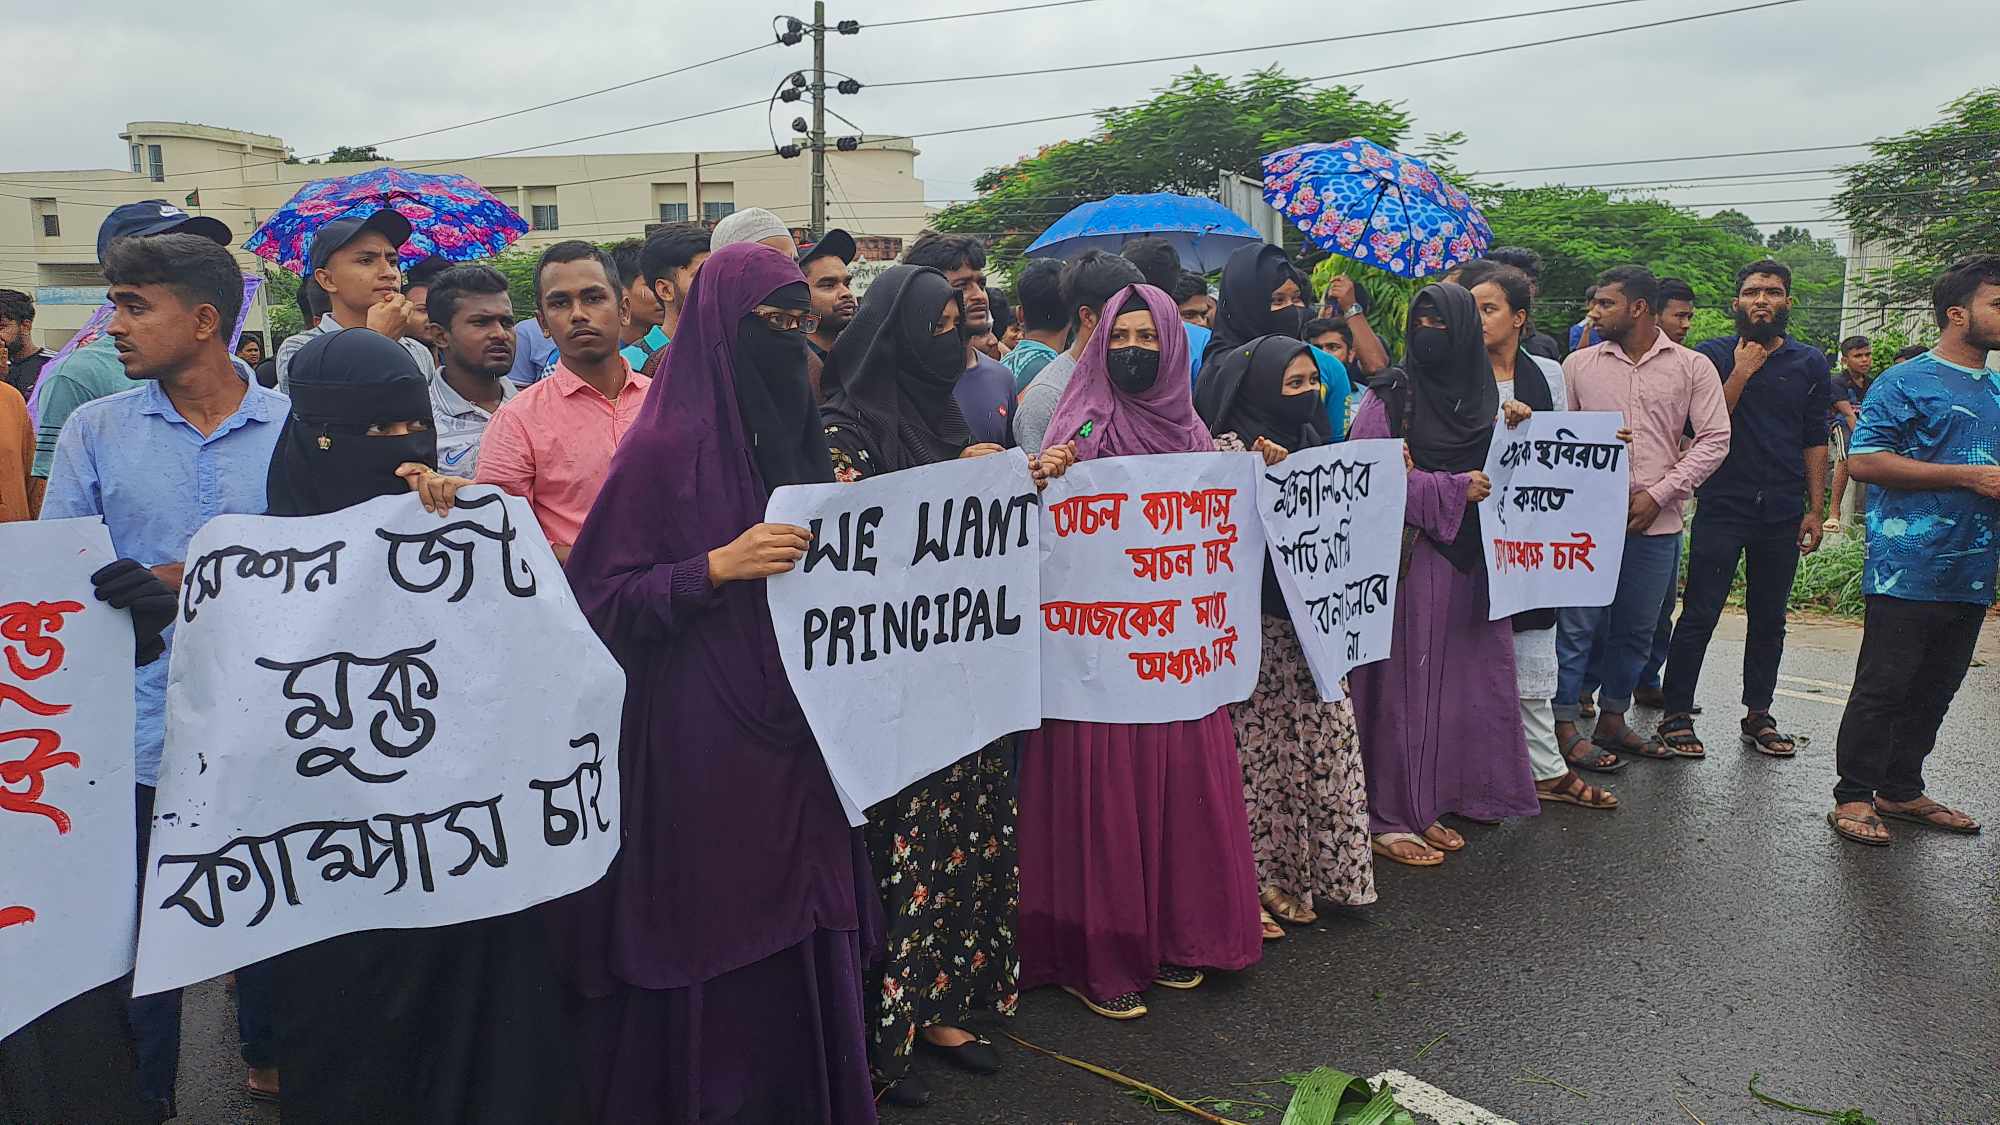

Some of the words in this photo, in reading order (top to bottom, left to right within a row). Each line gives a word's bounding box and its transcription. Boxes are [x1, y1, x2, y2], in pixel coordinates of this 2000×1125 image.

[1535, 429, 1624, 472] স্থবিরতা
[1050, 493, 1129, 537] অচল
[1514, 487, 1573, 512] করতে
[804, 507, 883, 576] WE
[911, 493, 1038, 566] WANT
[1124, 544, 1196, 581] সচল
[1203, 523, 1238, 574] চাই
[1550, 533, 1596, 571] চাই
[183, 541, 346, 622] সেশন
[804, 585, 1020, 671] PRINCIPAL
[1040, 599, 1182, 640] আজকের
[255, 640, 438, 783] মুক্ত
[529, 733, 610, 846] চাই
